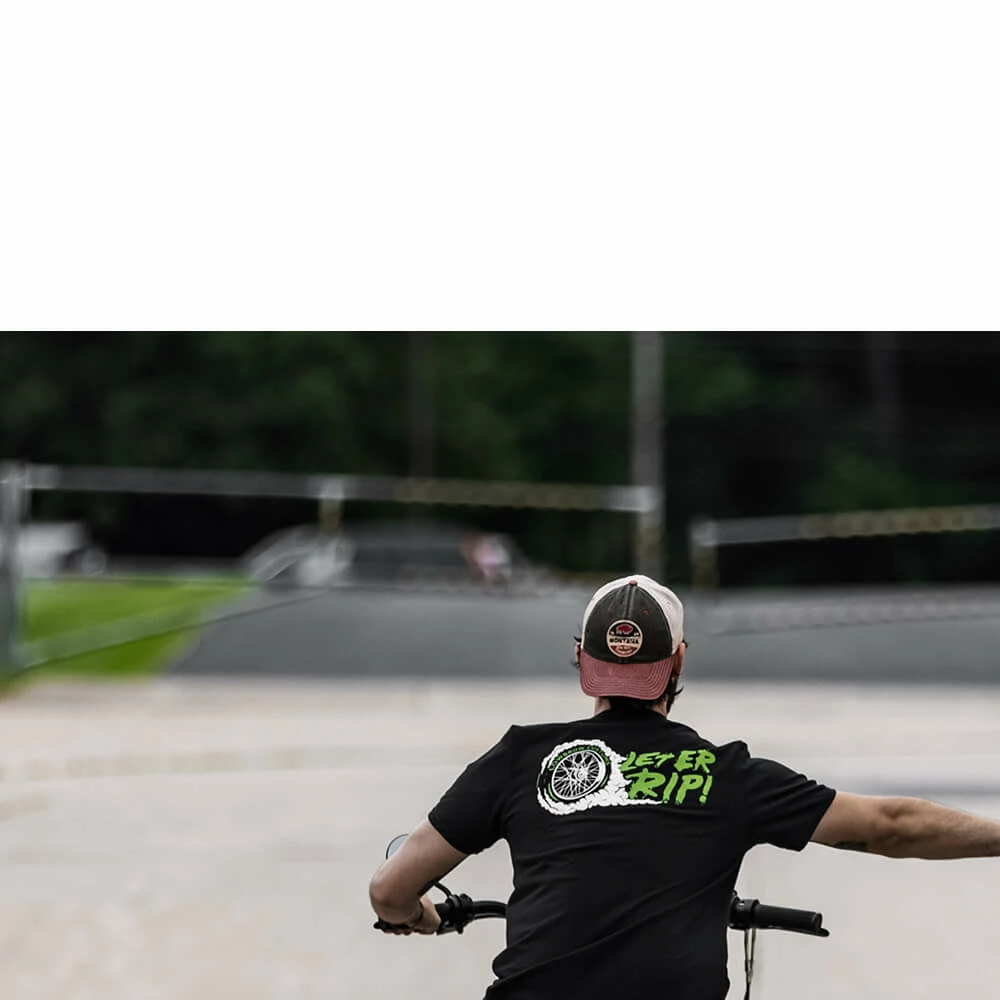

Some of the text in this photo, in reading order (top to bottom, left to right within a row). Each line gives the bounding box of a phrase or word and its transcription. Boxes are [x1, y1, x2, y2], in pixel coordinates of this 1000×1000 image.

[619, 749, 716, 773] LET ER
[625, 768, 713, 804] RIP!
